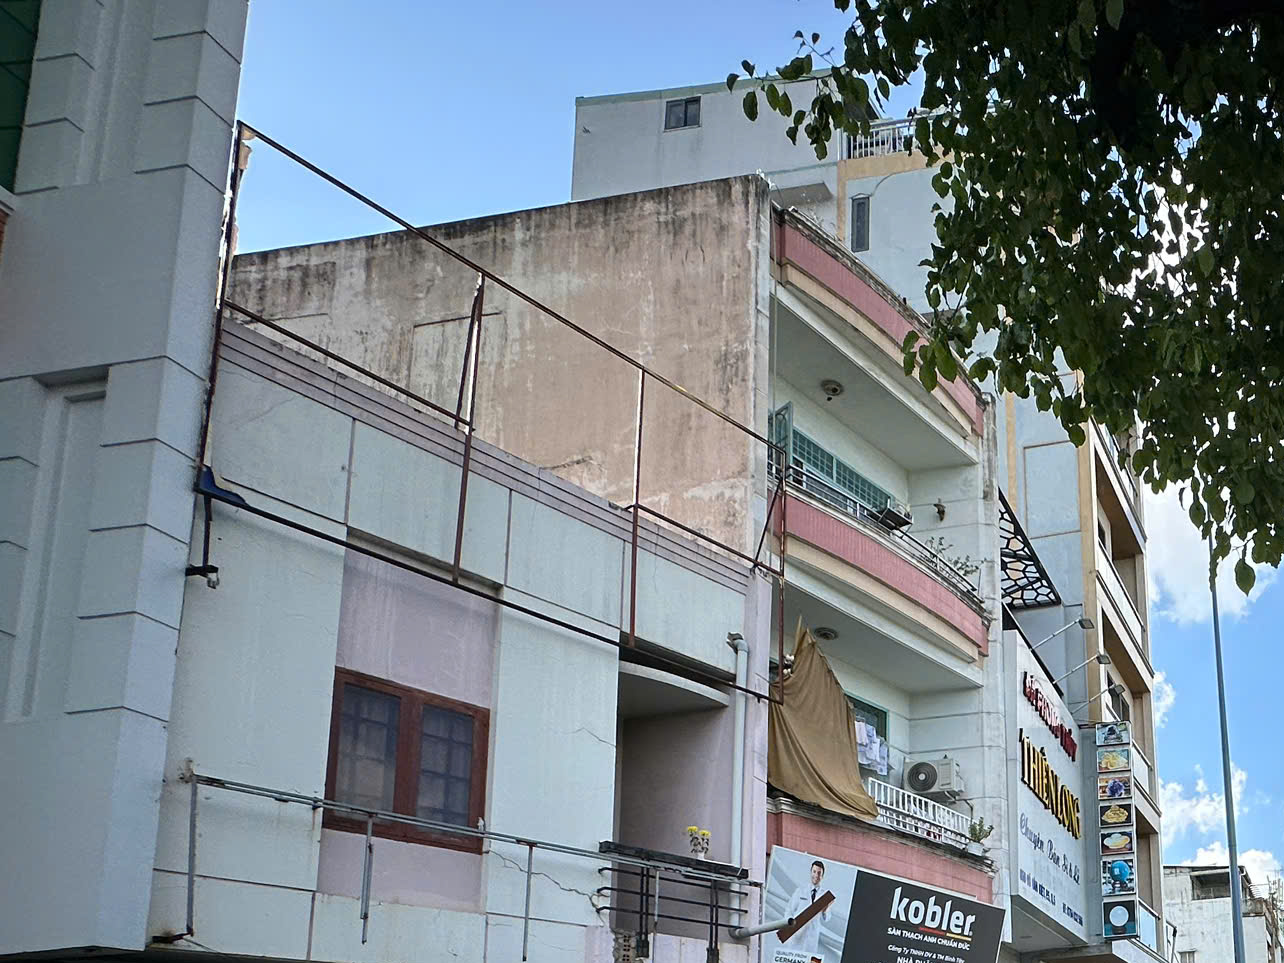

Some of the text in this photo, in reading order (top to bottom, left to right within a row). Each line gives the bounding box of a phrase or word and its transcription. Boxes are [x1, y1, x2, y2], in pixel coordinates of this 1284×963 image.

[1055, 774, 1081, 840] LONG
[890, 886, 976, 936] kobler
[887, 927, 901, 937] SÀN
[923, 935, 937, 944] ANH
[888, 944, 902, 953] Công
